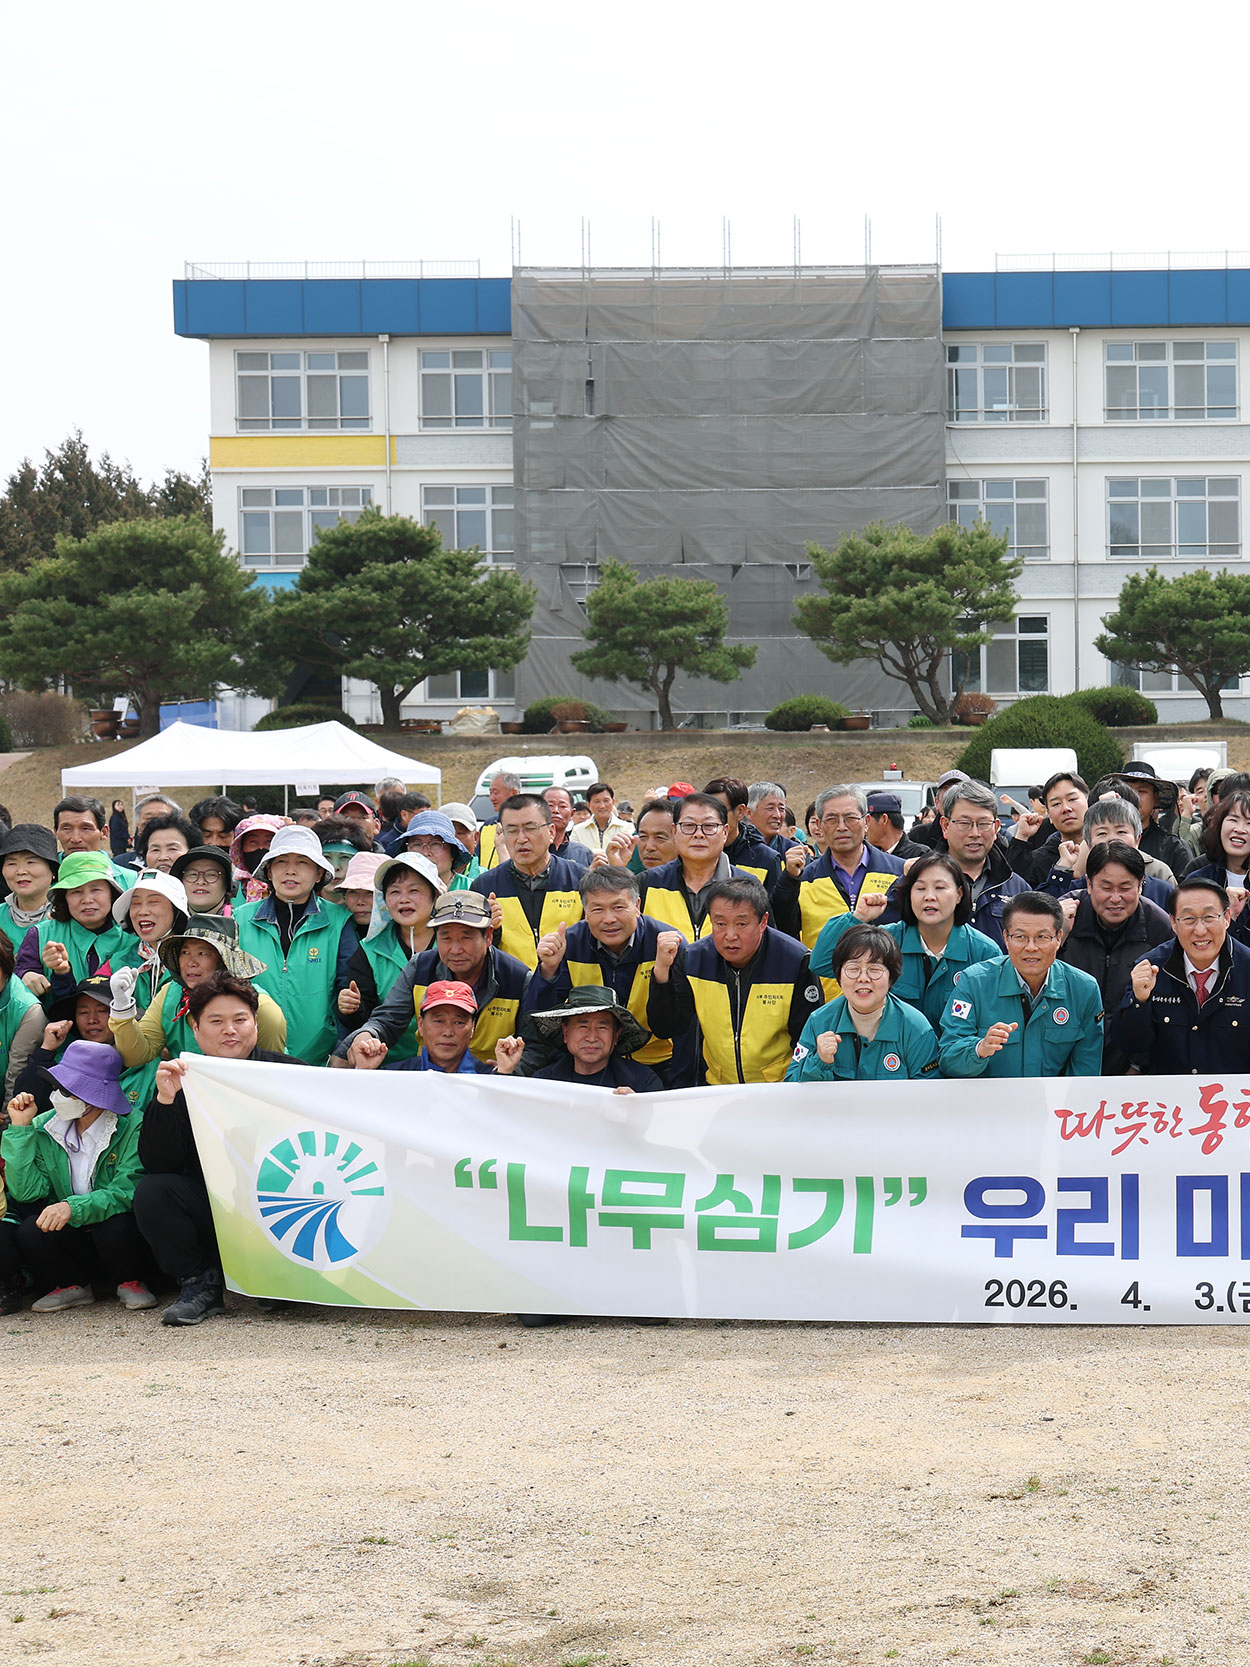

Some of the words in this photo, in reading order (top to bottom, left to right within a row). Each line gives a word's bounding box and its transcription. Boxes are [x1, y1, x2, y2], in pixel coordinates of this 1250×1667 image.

[1053, 1099, 1183, 1156] 따뜻한
[960, 1172, 1140, 1261] 우리
[984, 1278, 1079, 1312] 2026.
[1119, 1280, 1152, 1312] 4.
